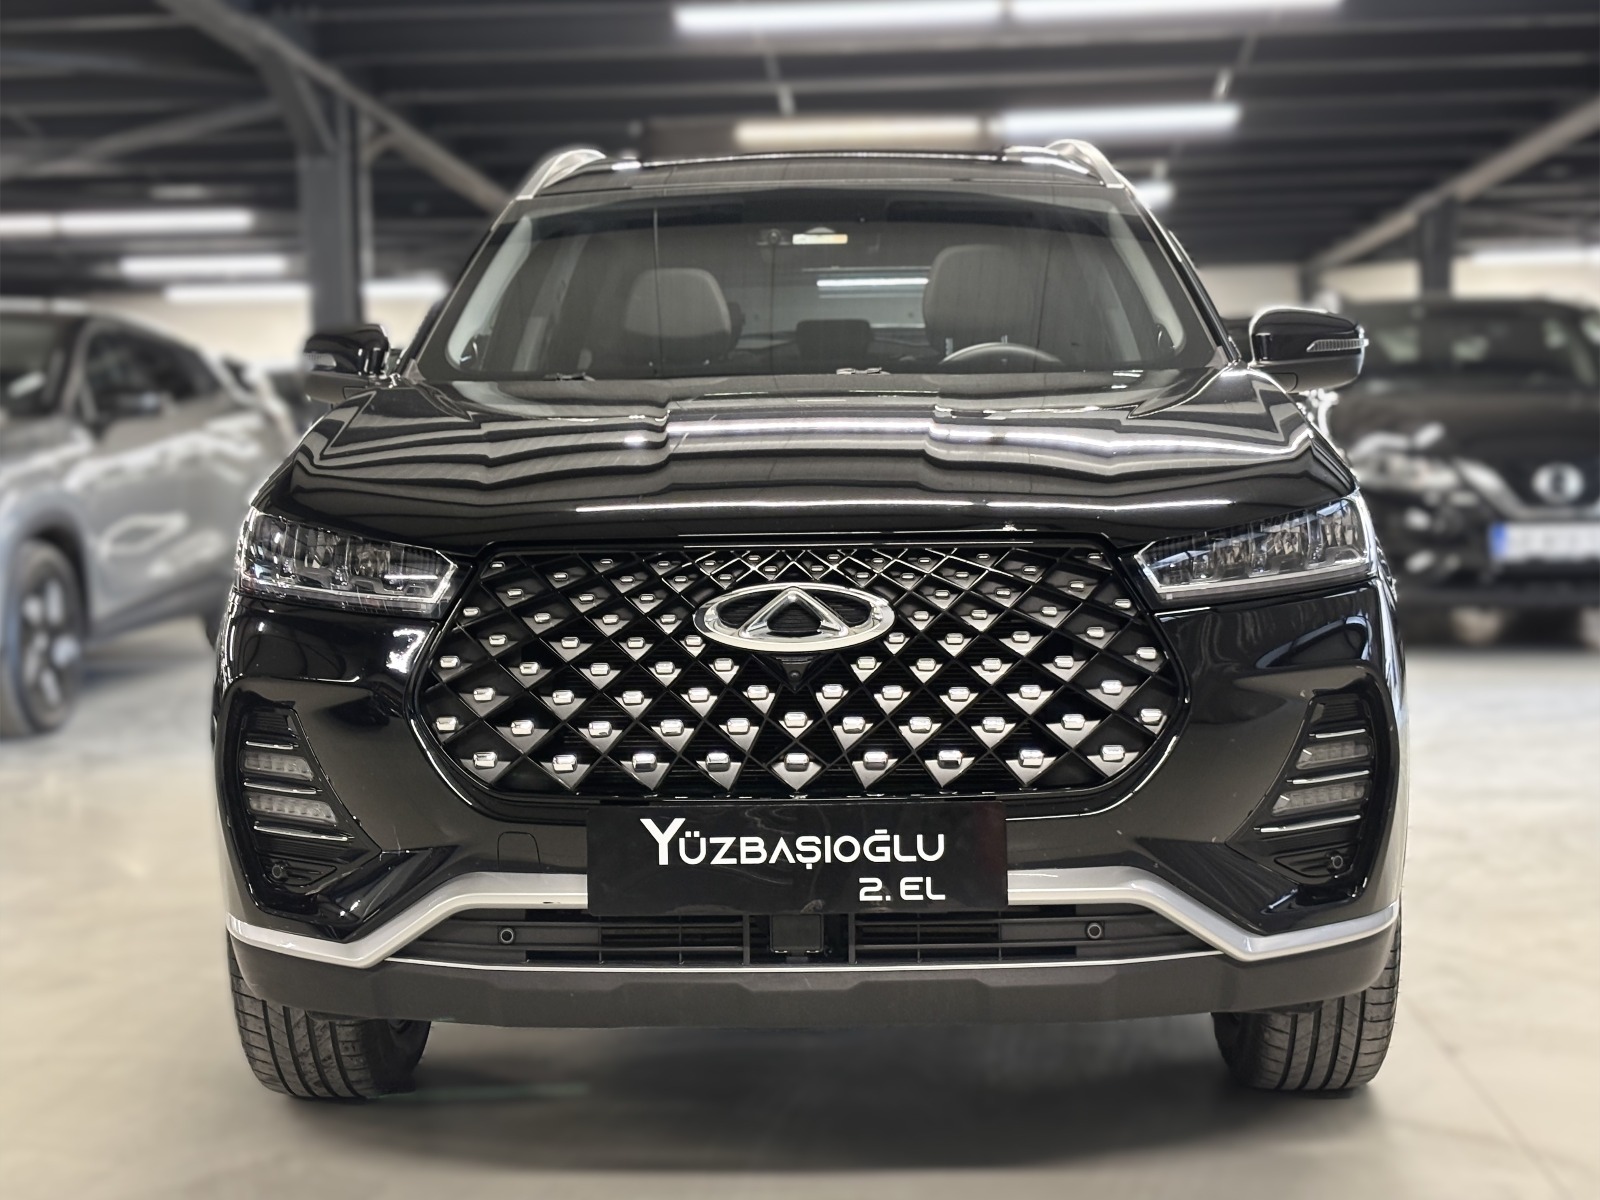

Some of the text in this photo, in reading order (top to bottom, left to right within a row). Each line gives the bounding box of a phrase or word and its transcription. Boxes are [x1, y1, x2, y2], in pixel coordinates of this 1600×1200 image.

[640, 817, 945, 870] YÜZBAŞIOĞLU
[858, 876, 946, 902] 2. EL
